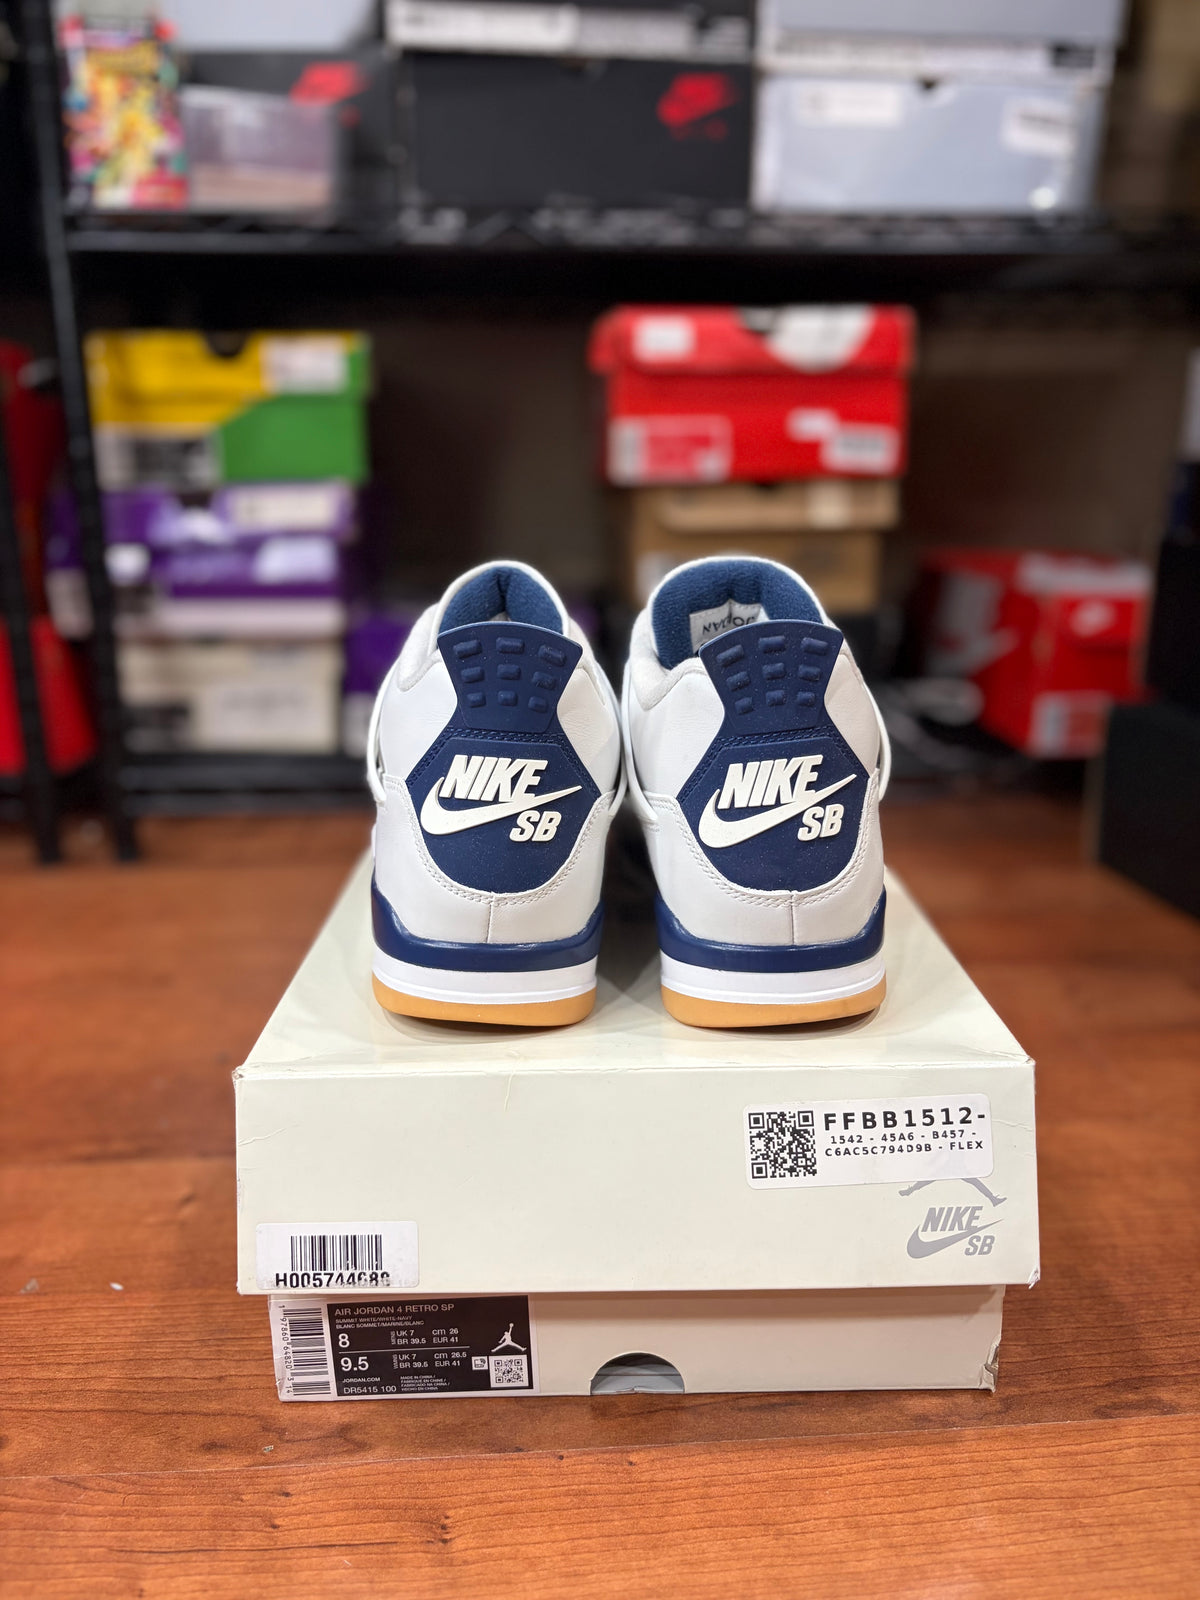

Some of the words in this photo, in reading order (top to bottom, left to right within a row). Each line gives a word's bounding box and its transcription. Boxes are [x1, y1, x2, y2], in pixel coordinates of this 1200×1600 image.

[439, 755, 548, 803] NIKE
[717, 755, 823, 809] NIKE
[509, 810, 562, 842] SB
[797, 803, 845, 841] SB
[823, 1106, 986, 1131] FFBB1512-
[825, 1143, 932, 1156] C6AC5C794D9B
[950, 1140, 984, 1151] FLEX
[830, 1135, 863, 1144] 1542
[881, 1131, 915, 1142] 45A6
[932, 1129, 965, 1139] B457
[921, 1206, 983, 1232] NIKE
[964, 1235, 996, 1256] SB
[334, 1308, 352, 1316] AIR
[353, 1306, 395, 1315] JORDAN
[405, 1303, 439, 1312] RETRO
[441, 1303, 455, 1311] SP
[280, 1317, 289, 1342] 97860
[338, 1333, 350, 1348] 8
[283, 1345, 293, 1370] 64820
[340, 1356, 370, 1372] 9.5
[343, 1386, 379, 1394] DR5415
[380, 1385, 397, 1393] 100
